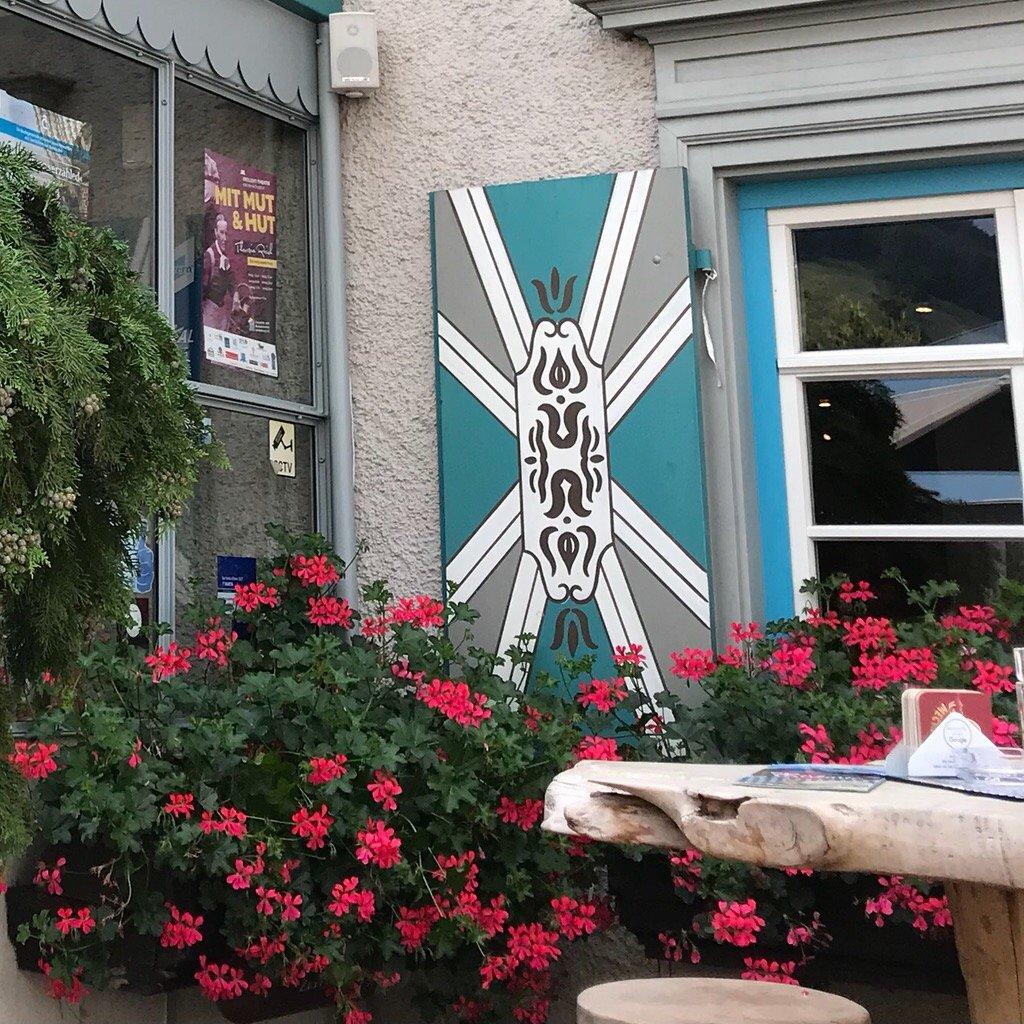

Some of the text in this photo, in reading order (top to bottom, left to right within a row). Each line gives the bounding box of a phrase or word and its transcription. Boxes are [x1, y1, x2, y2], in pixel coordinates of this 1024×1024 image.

[215, 185, 274, 213] MIT MUT
[233, 210, 276, 235] & HUT
